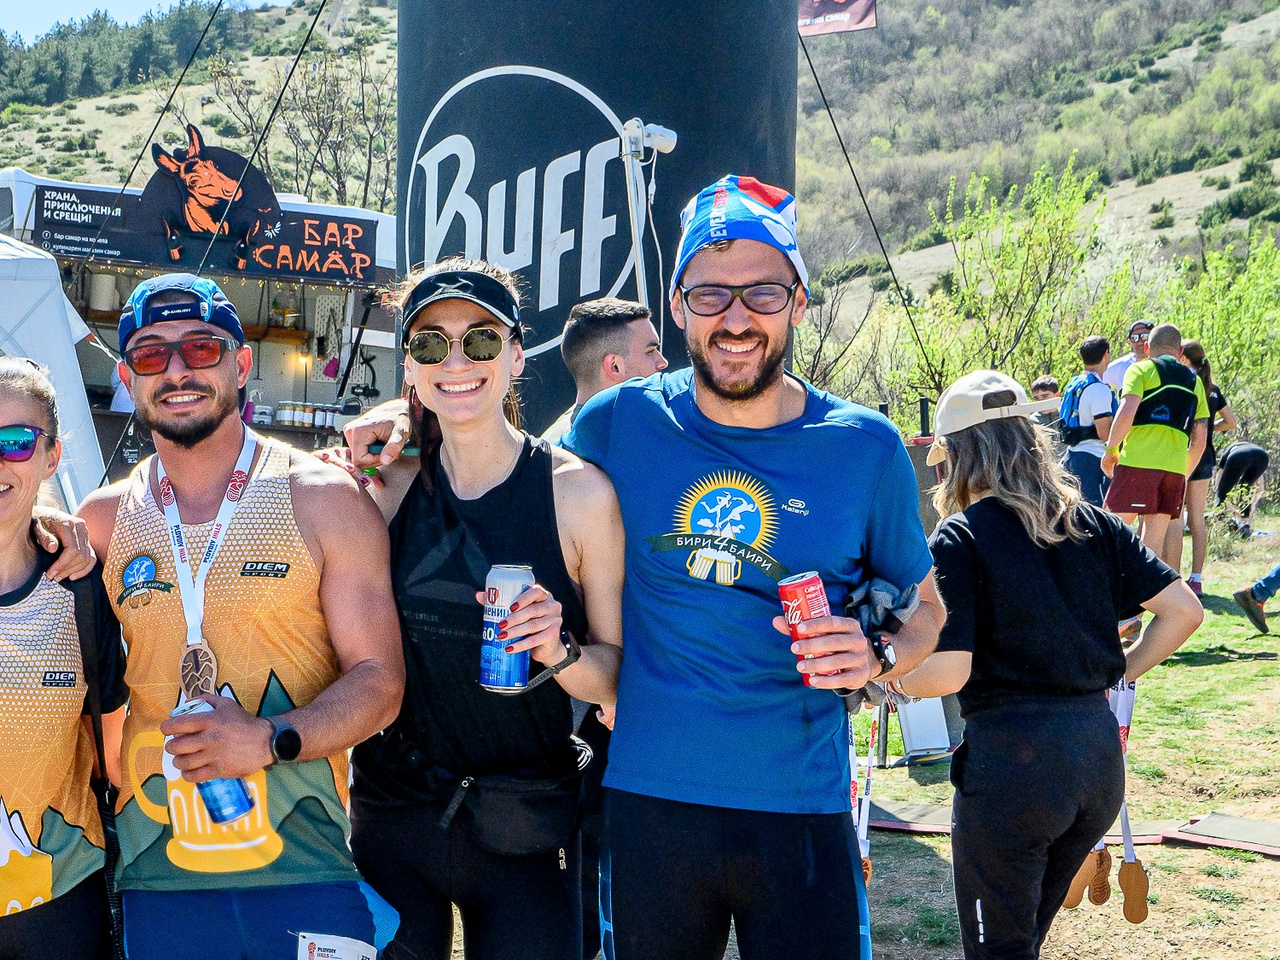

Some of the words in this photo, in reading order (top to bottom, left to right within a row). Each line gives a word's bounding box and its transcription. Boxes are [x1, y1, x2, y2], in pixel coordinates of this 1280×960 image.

[44, 190, 80, 203] ХРАНА,
[43, 200, 122, 217] ПРИКЛЮЧЕНИЯ
[43, 209, 52, 219] И
[53, 210, 92, 223] СРЕЩИ!
[303, 219, 364, 250] БАР
[252, 244, 371, 279] САМАР
[676, 536, 712, 549] БИРИ
[729, 544, 773, 571] БАИРИ
[245, 562, 289, 572] DIEM
[45, 672, 76, 681] DIEM
